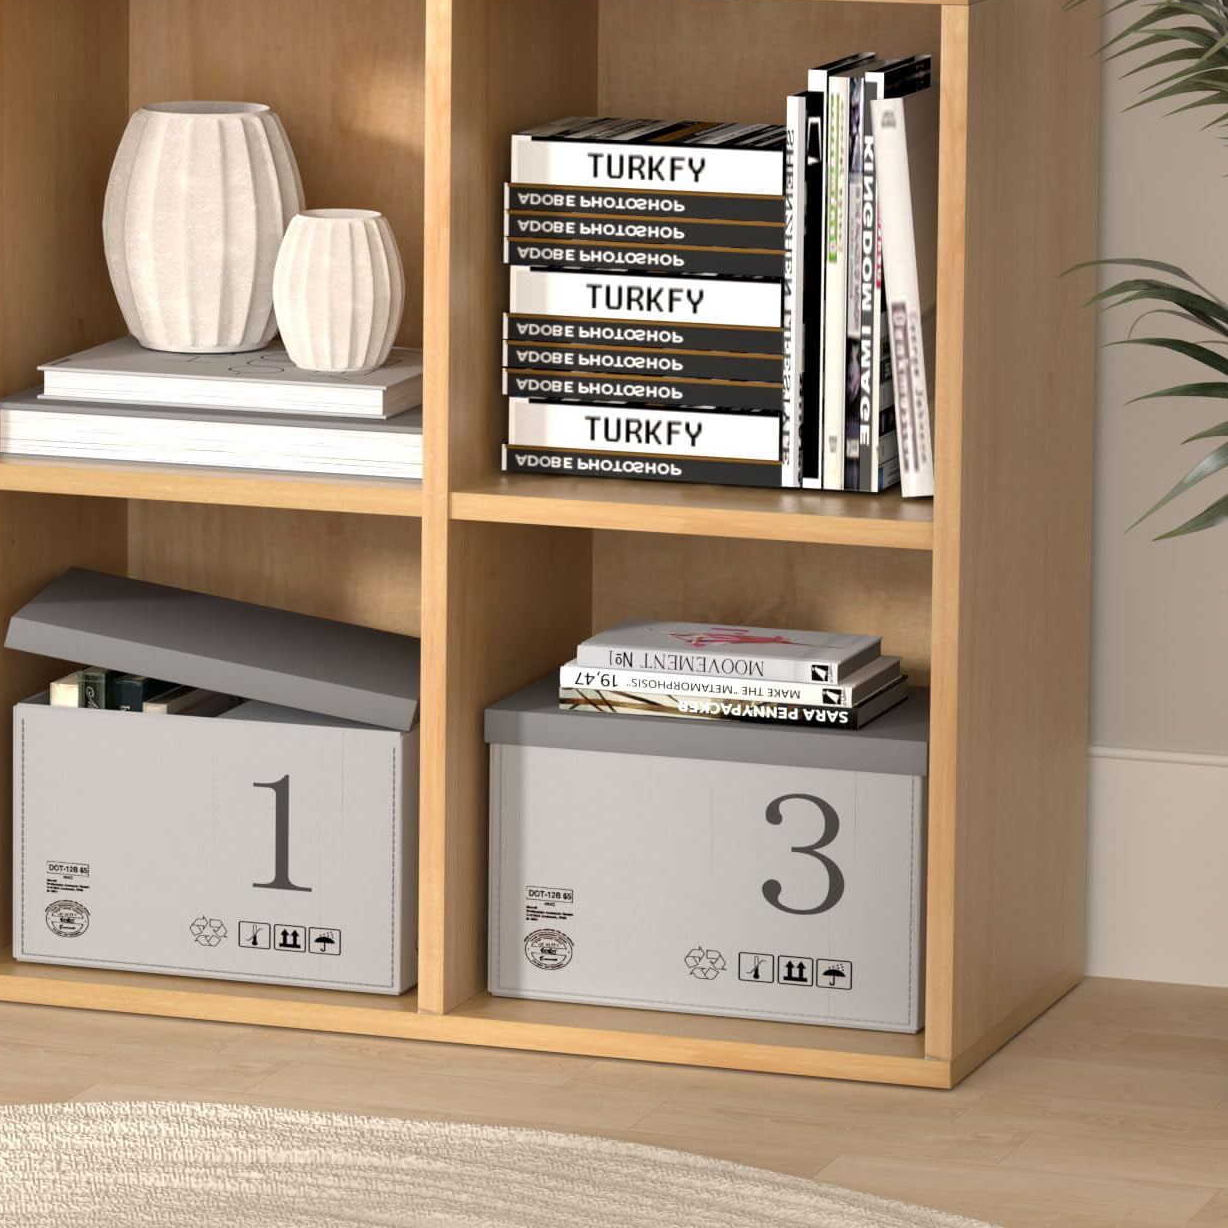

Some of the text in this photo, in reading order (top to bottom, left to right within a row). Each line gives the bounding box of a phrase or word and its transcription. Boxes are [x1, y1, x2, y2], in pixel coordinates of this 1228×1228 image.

[587, 152, 706, 183] TURKFY
[586, 283, 704, 314] TURKFY
[584, 415, 703, 447] TURKFY
[641, 653, 764, 677] MOOVEMENT
[575, 671, 801, 700] MAKE THE "METAMORPHOSIS" 19,47
[678, 699, 849, 724] SARA PENNYPACKER
[253, 775, 312, 893] 1
[762, 794, 845, 915] 3
